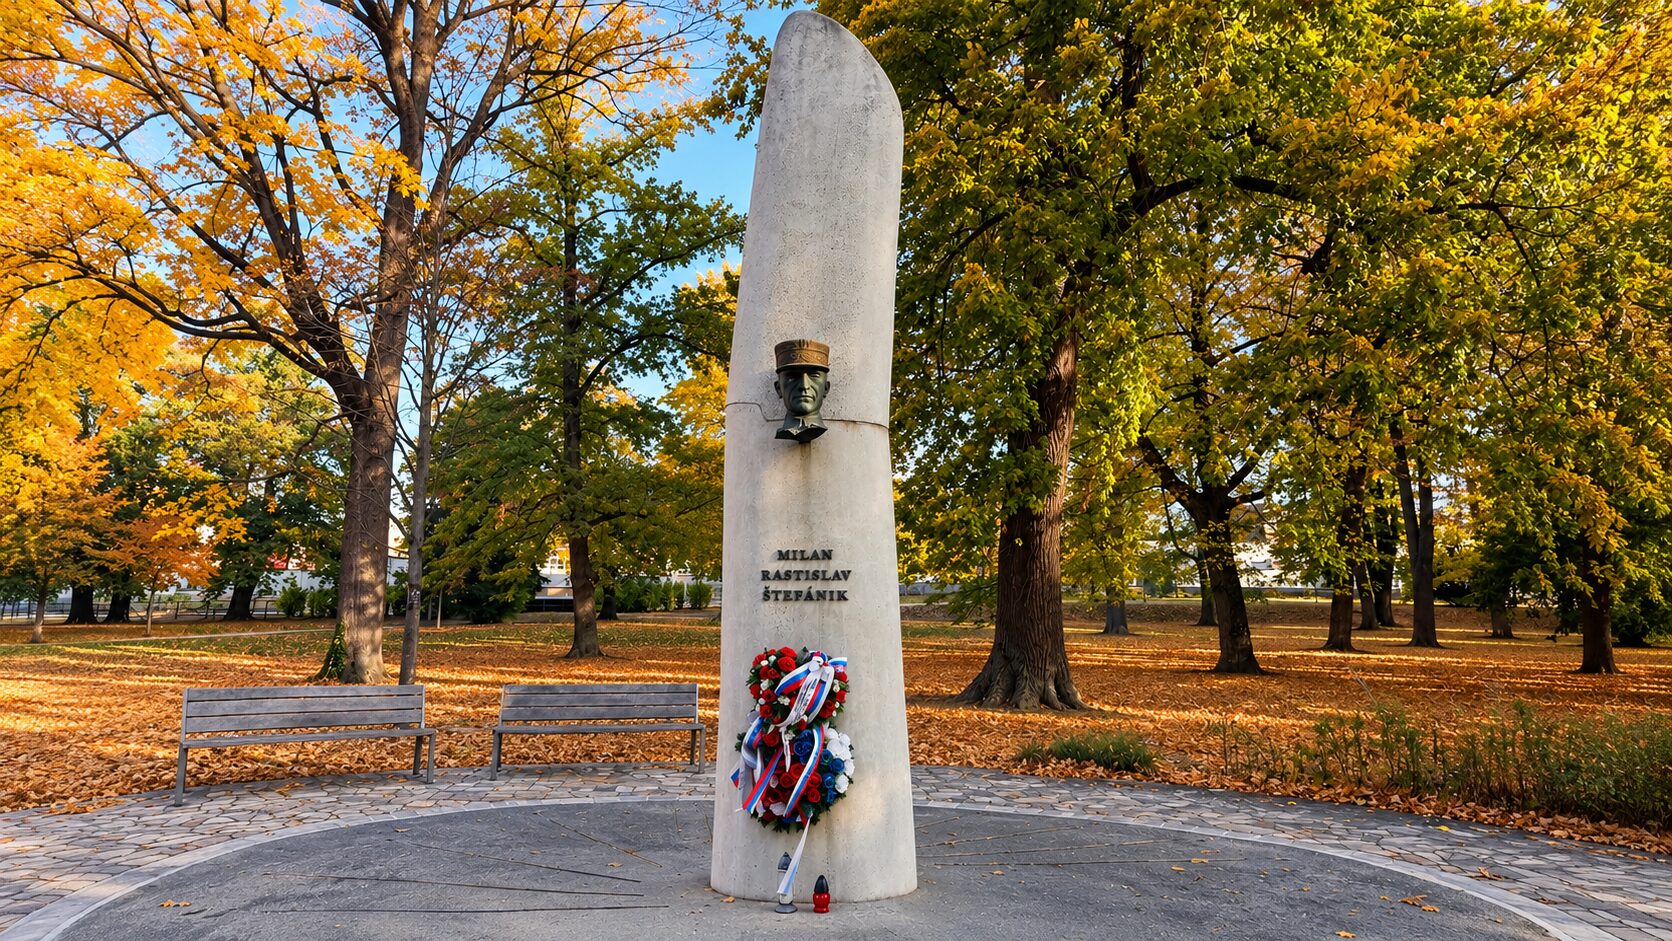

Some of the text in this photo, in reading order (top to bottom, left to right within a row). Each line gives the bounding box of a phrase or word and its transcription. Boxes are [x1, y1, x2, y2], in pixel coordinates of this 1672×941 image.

[777, 549, 833, 560] MILAN
[761, 570, 852, 581] RASTISLAV
[762, 585, 849, 602] ŠTEFÁNIK
